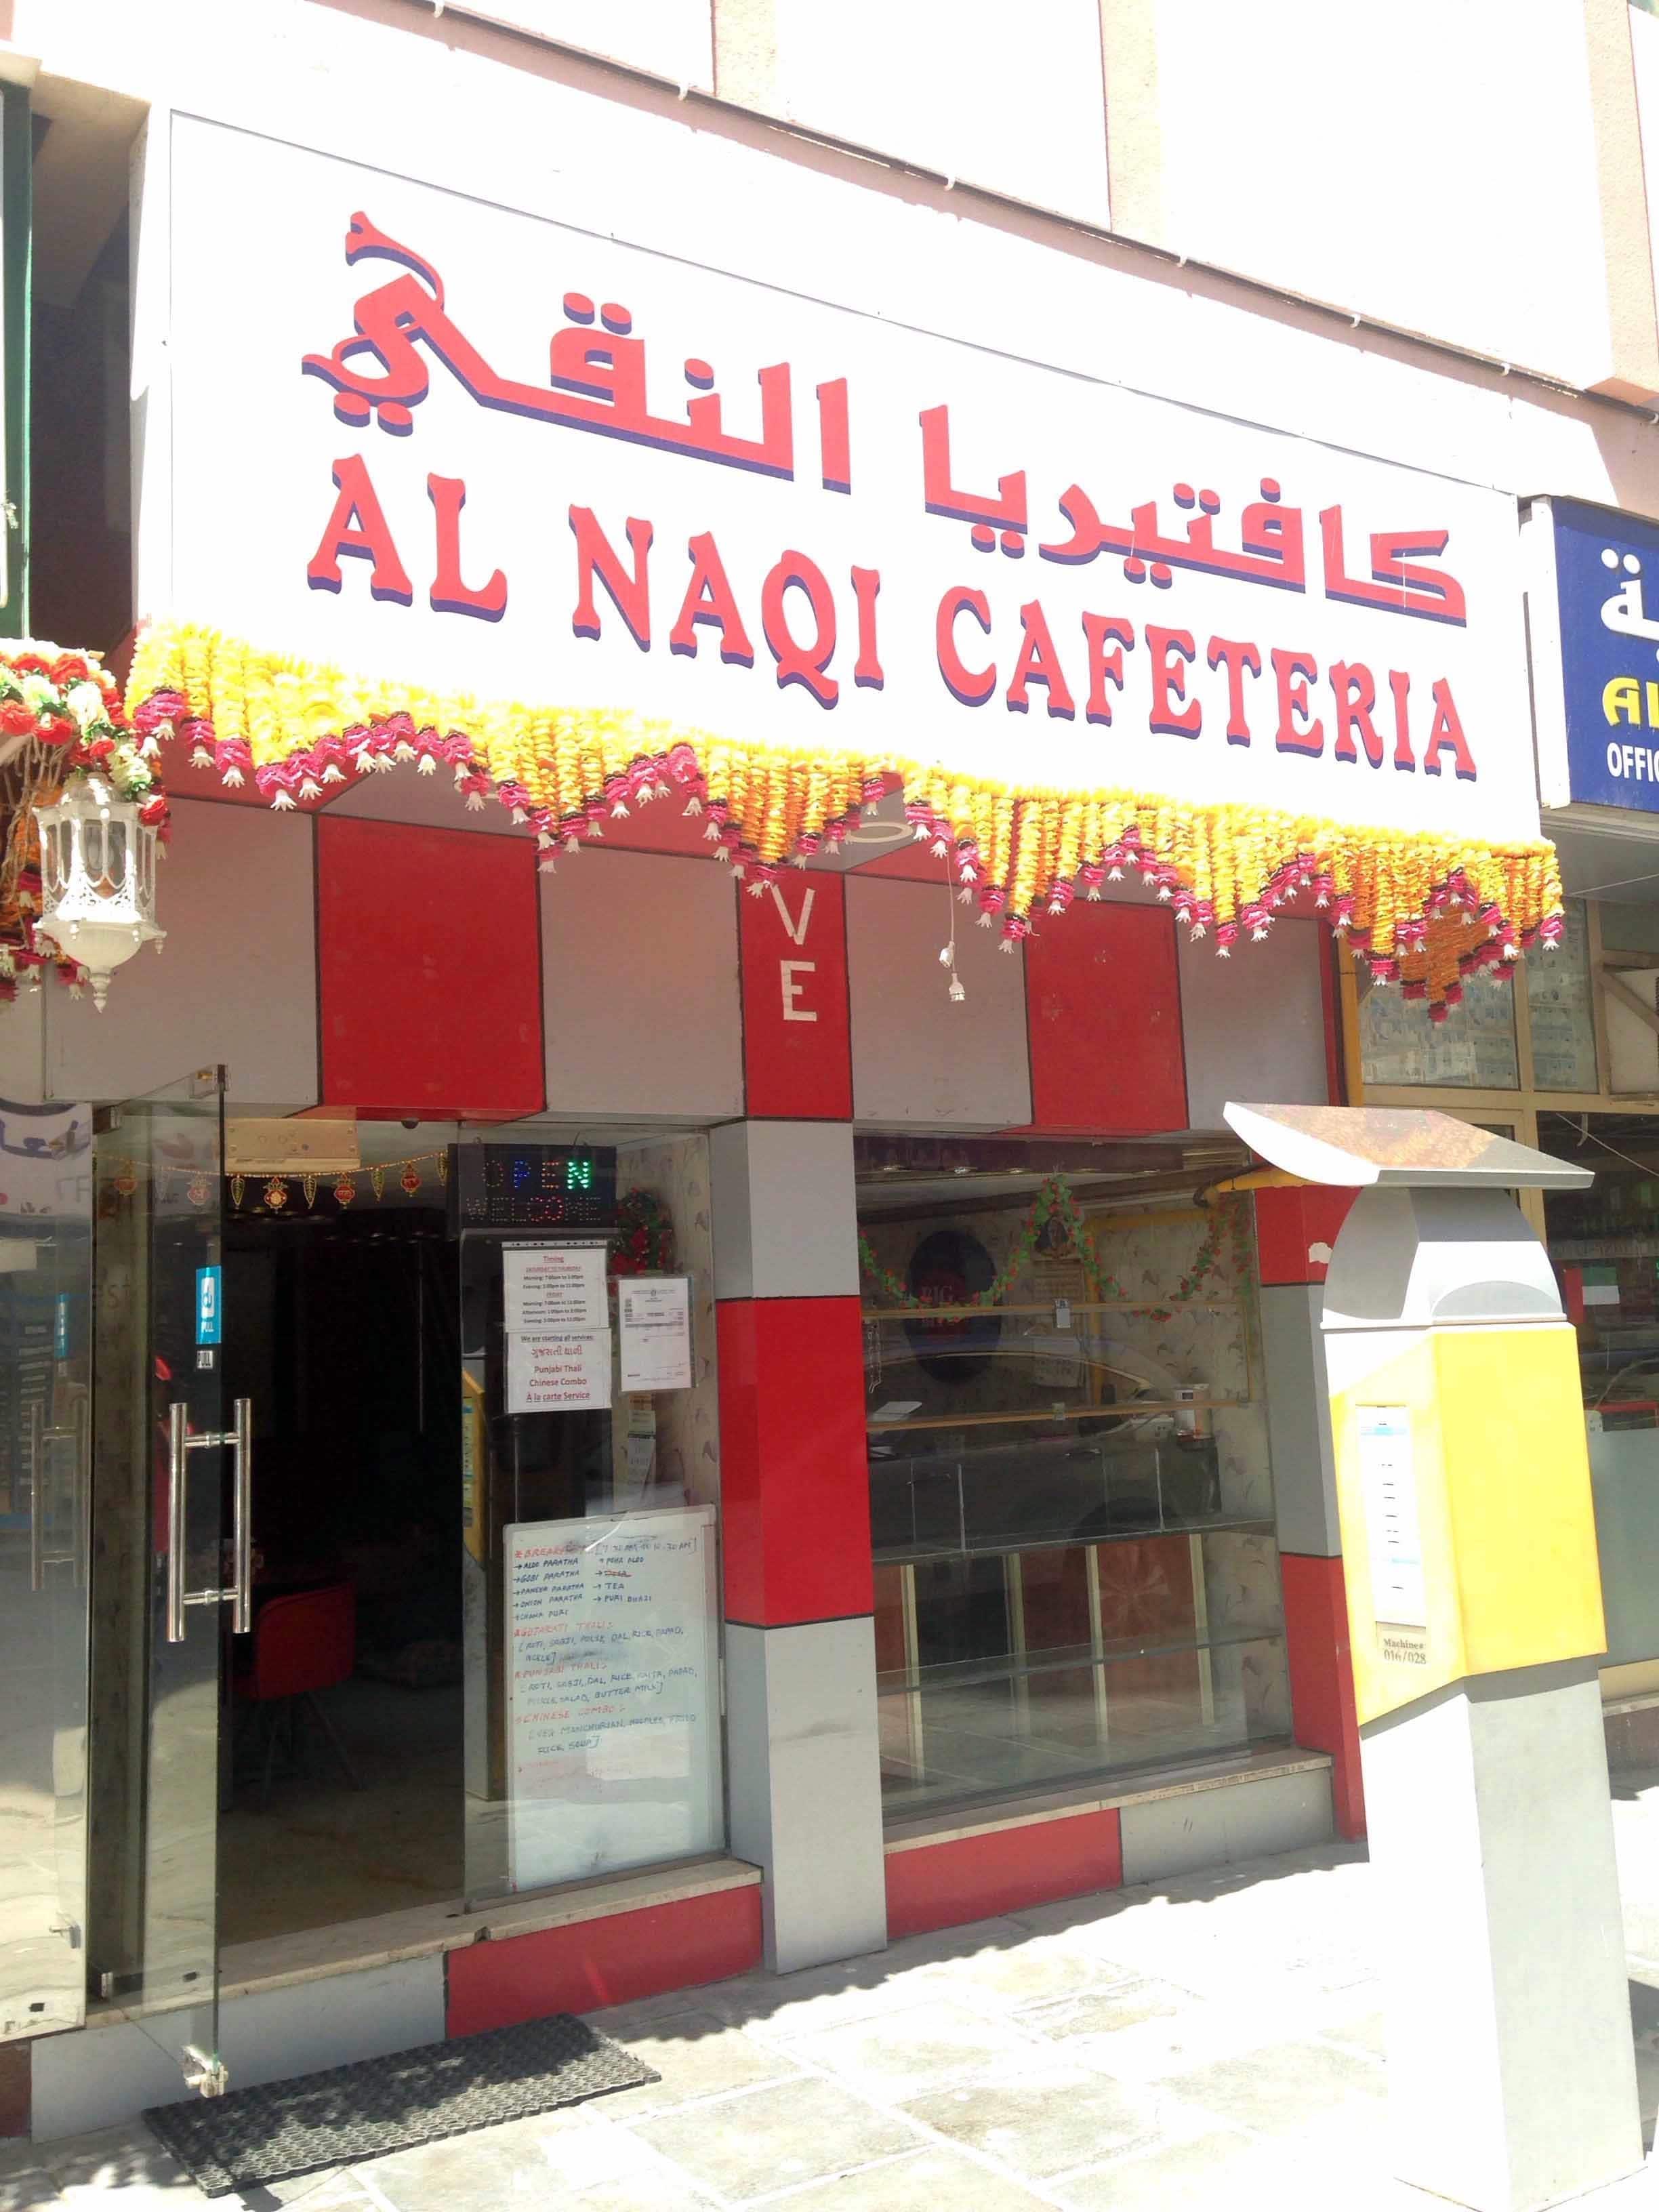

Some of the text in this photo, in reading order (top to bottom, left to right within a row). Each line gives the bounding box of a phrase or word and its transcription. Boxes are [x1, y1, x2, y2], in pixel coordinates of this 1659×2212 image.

[302, 211, 852, 495] النقي
[919, 405, 1467, 628] كافتيريا
[307, 453, 508, 622] AL
[568, 503, 884, 711] NAQI
[935, 585, 1477, 781] CAFETERIA
[1607, 742, 1659, 783] OFFI
[482, 1160, 594, 1189] OPEN
[530, 1377, 587, 1387] Chinese Combo
[534, 1364, 582, 1374] Punjabi Thali
[543, 1393, 562, 1401] carte
[564, 1391, 590, 1399] Service
[543, 1557, 579, 1567] PARATHA
